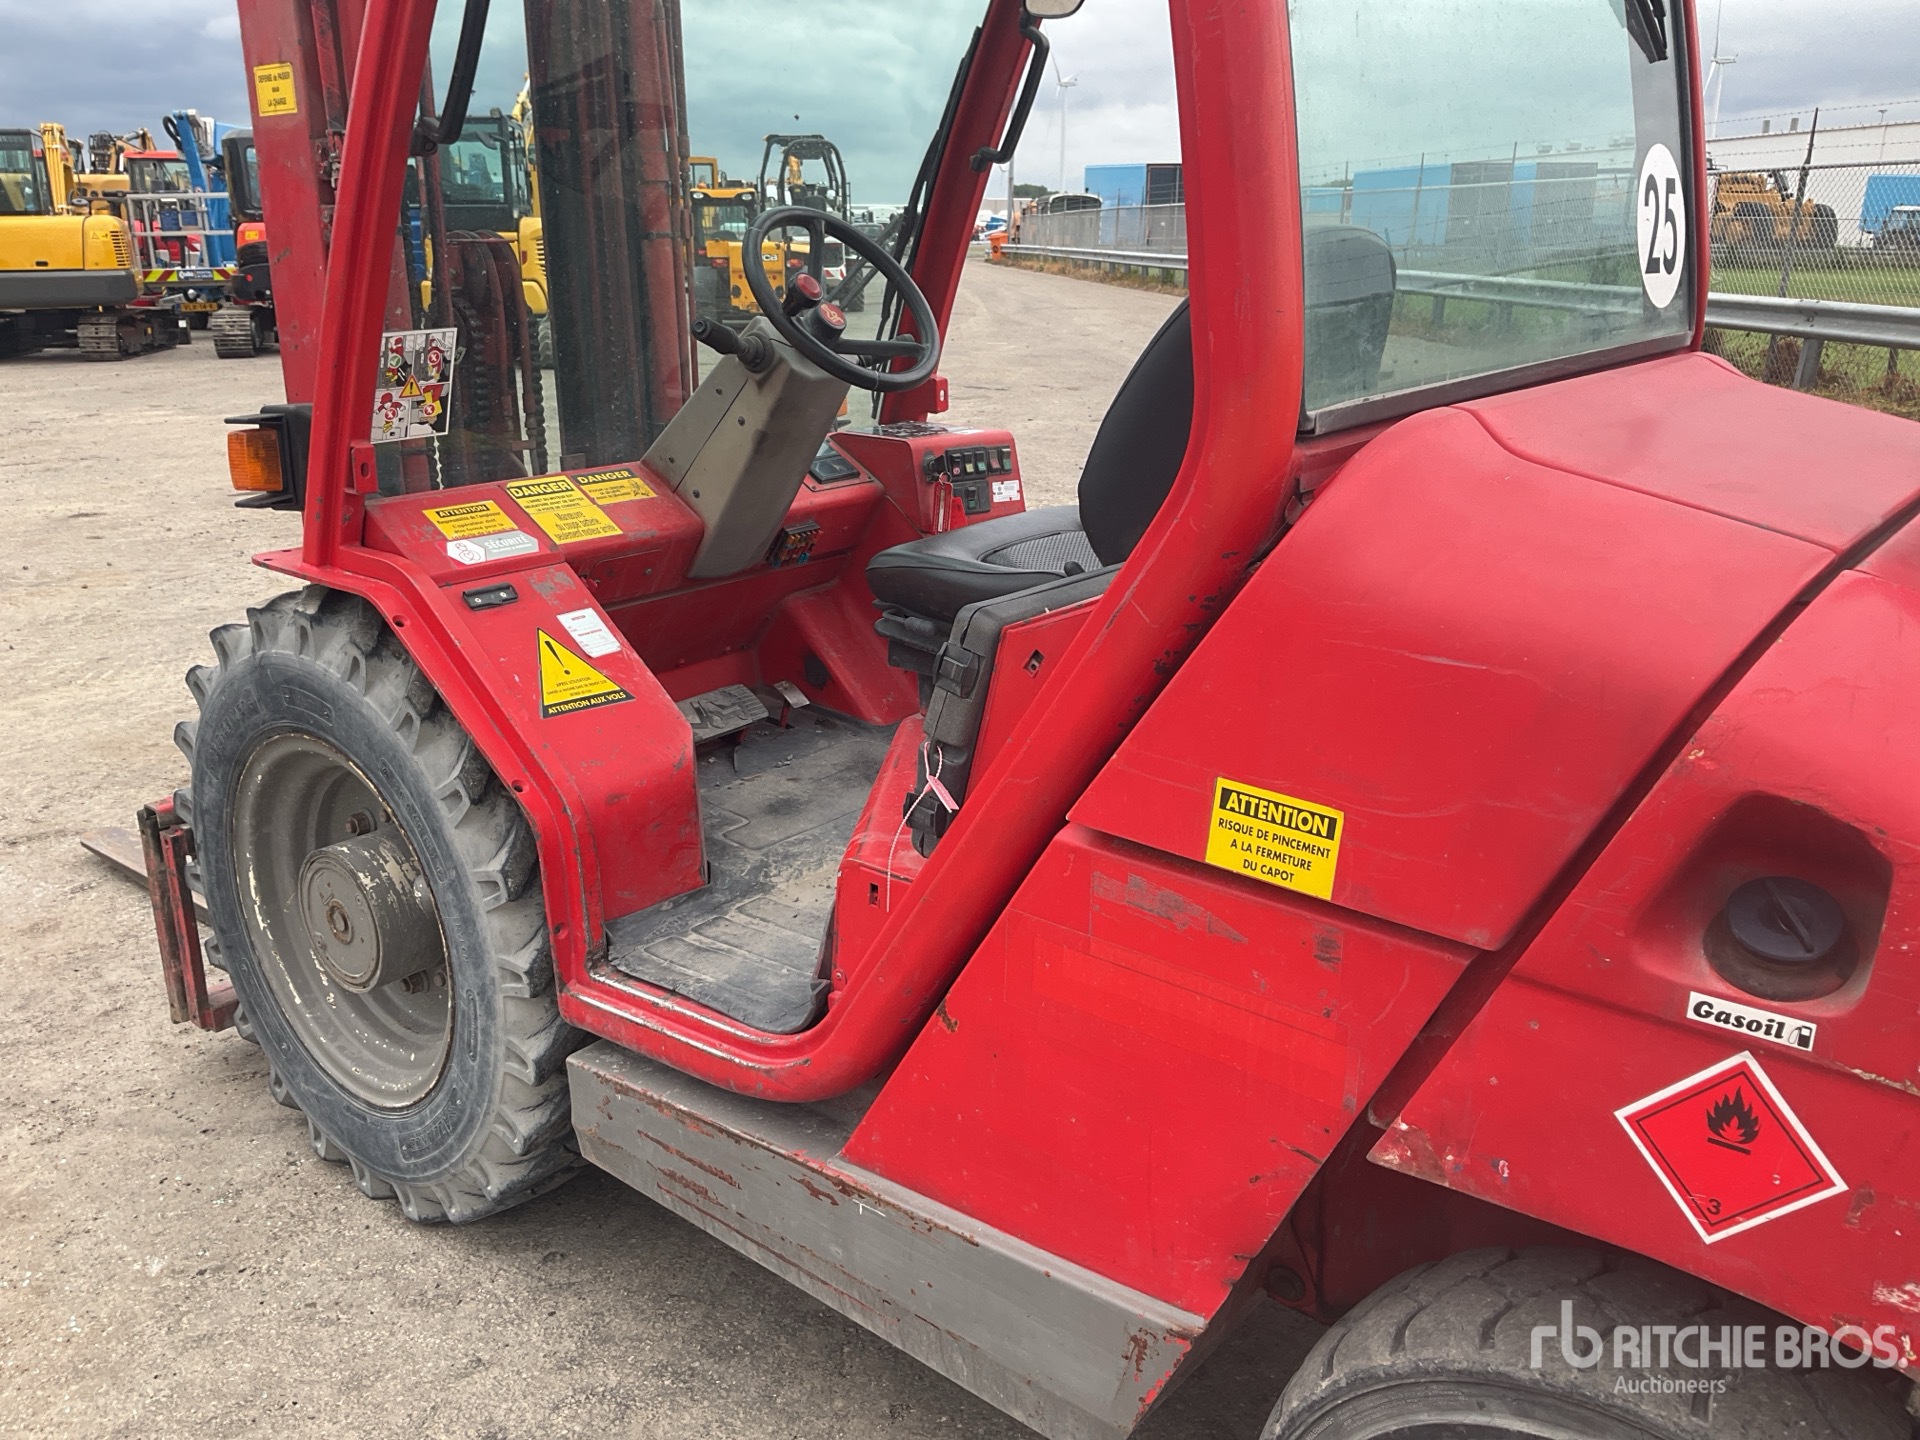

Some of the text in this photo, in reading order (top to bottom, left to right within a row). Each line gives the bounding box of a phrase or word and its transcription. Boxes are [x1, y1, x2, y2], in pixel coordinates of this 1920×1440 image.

[1644, 174, 1678, 275] 25
[576, 470, 632, 483] DANGER
[510, 481, 572, 497] DANGER
[440, 504, 488, 517] ATTENTION
[484, 534, 529, 550] SÉCURITÉ
[548, 692, 626, 714] ATTENTION AUX VOLS
[1226, 792, 1329, 837] ATTENTION
[1218, 817, 1331, 859] RISQUE DE PINCEMENT
[1230, 838, 1312, 871] A LA FERMETURE
[1243, 859, 1294, 882] DU CAPOT
[1693, 1000, 1786, 1040] Gasoil
[1706, 1198, 1721, 1215] 3
